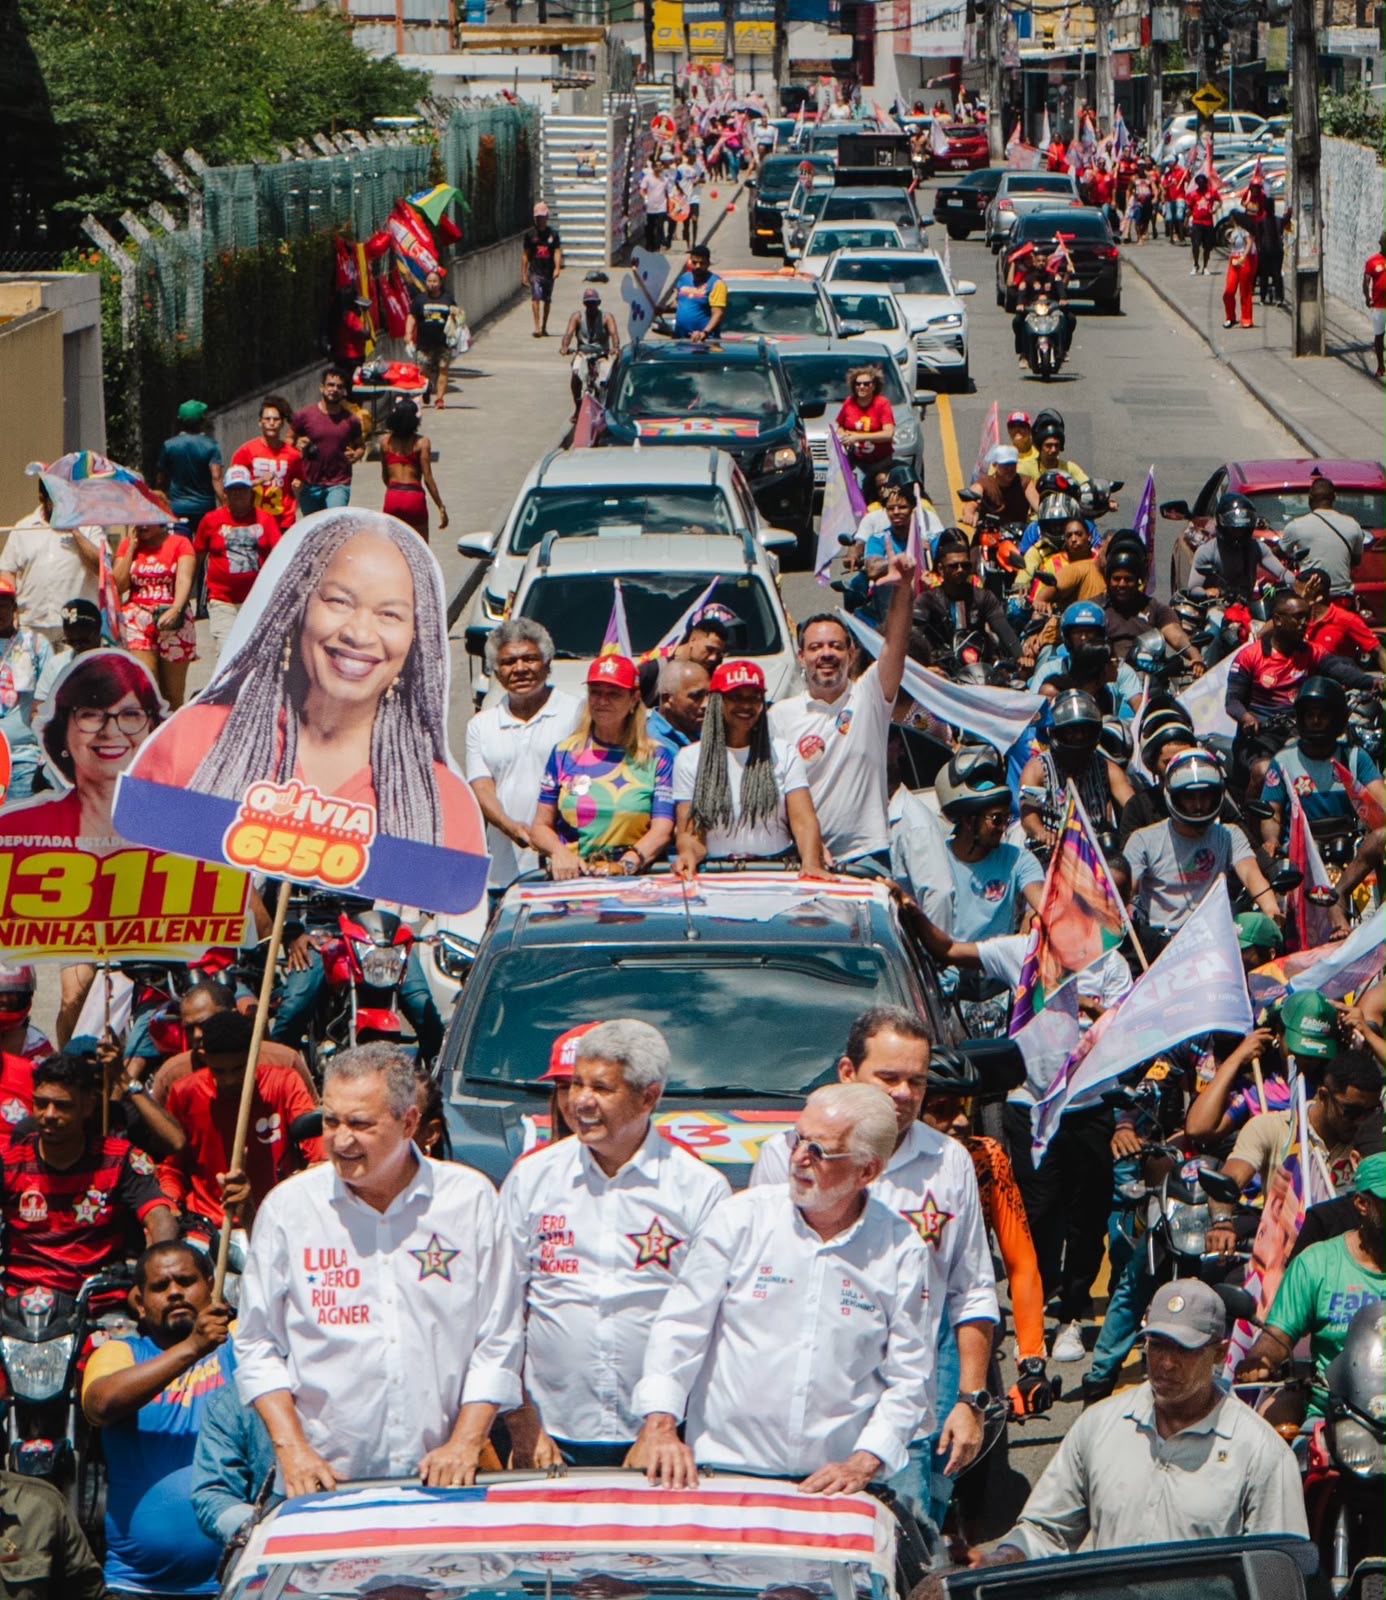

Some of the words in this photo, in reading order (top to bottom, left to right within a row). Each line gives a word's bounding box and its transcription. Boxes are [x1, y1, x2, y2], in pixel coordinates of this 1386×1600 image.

[726, 669, 760, 685] LULA
[231, 824, 361, 879] 6550
[0, 850, 248, 919] 13111
[104, 918, 245, 945] VALENTE
[921, 1212, 938, 1233] 13
[648, 1235, 665, 1254] 13
[304, 1248, 348, 1272] LULA
[427, 1252, 442, 1268] 13
[321, 1268, 361, 1289] JERO
[312, 1288, 337, 1308] RUI
